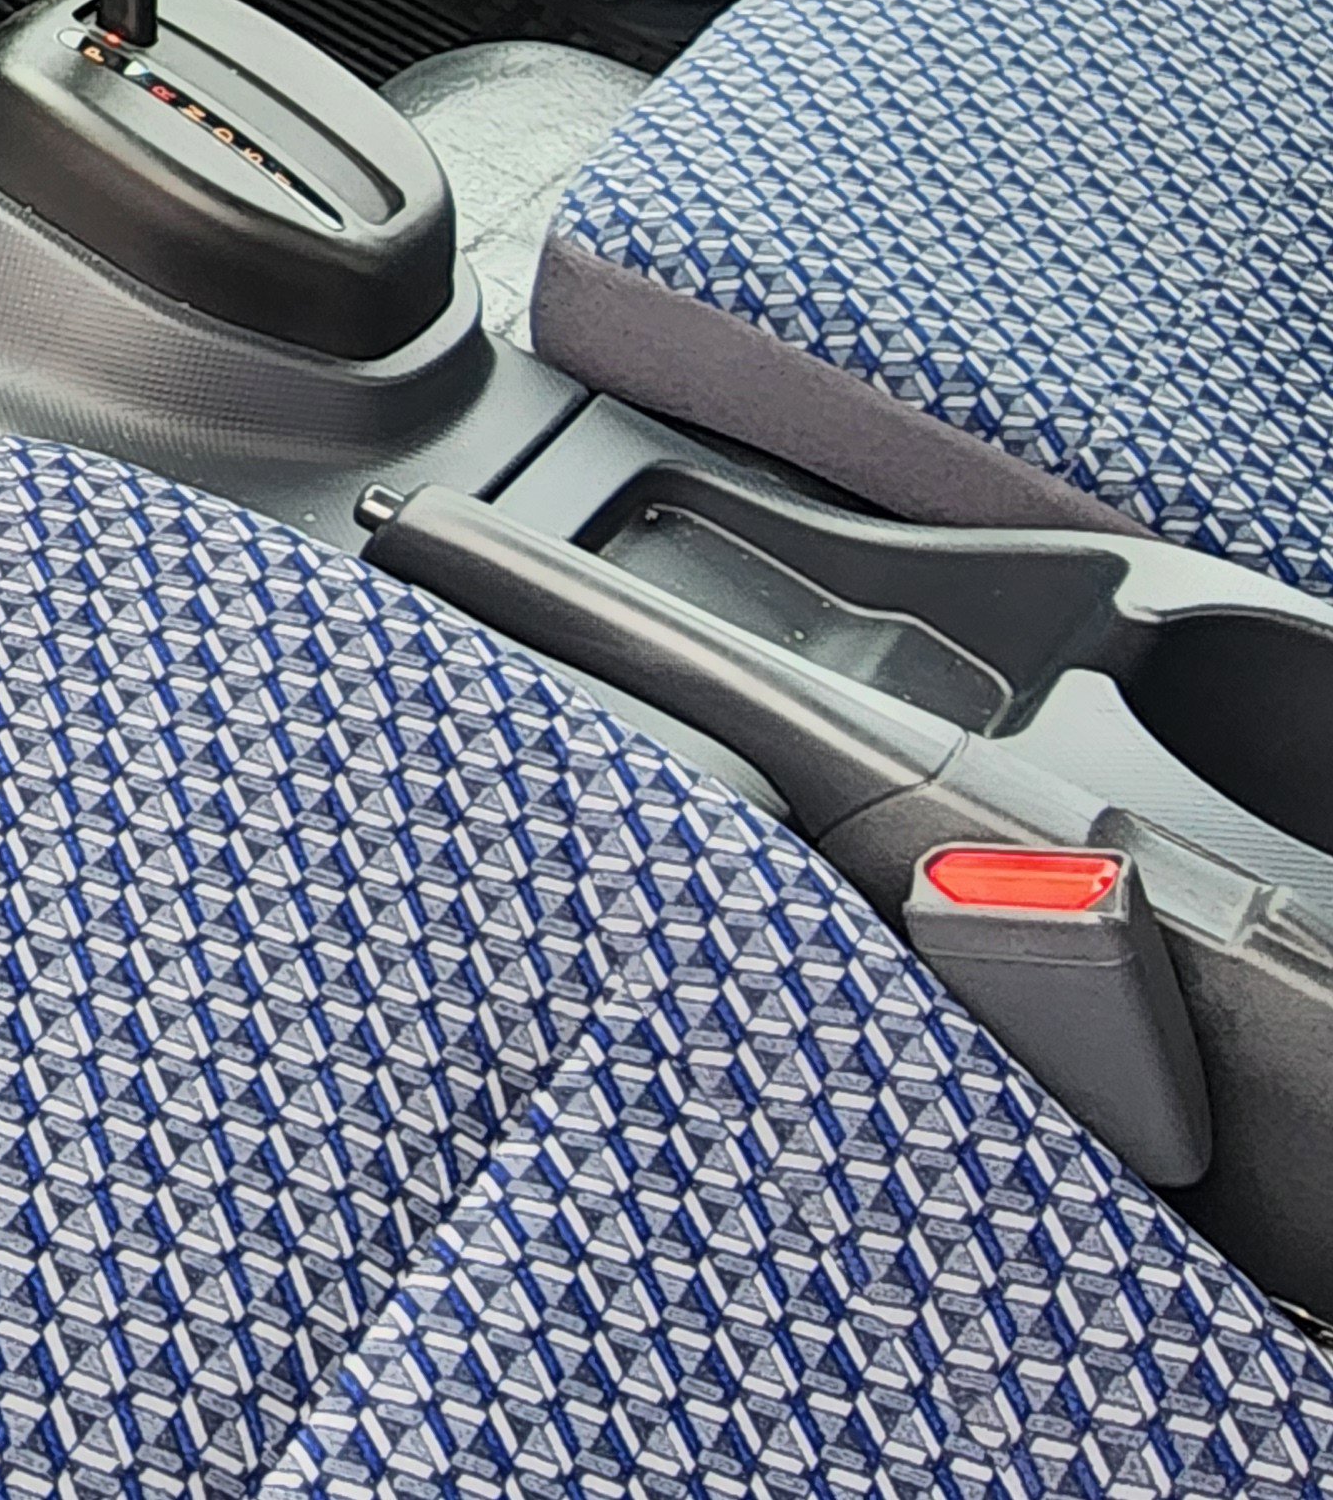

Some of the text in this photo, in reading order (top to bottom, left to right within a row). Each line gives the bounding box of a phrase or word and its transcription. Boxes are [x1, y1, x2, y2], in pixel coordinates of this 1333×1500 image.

[83, 45, 105, 63] P
[151, 85, 176, 101] R
[212, 127, 234, 143] D
